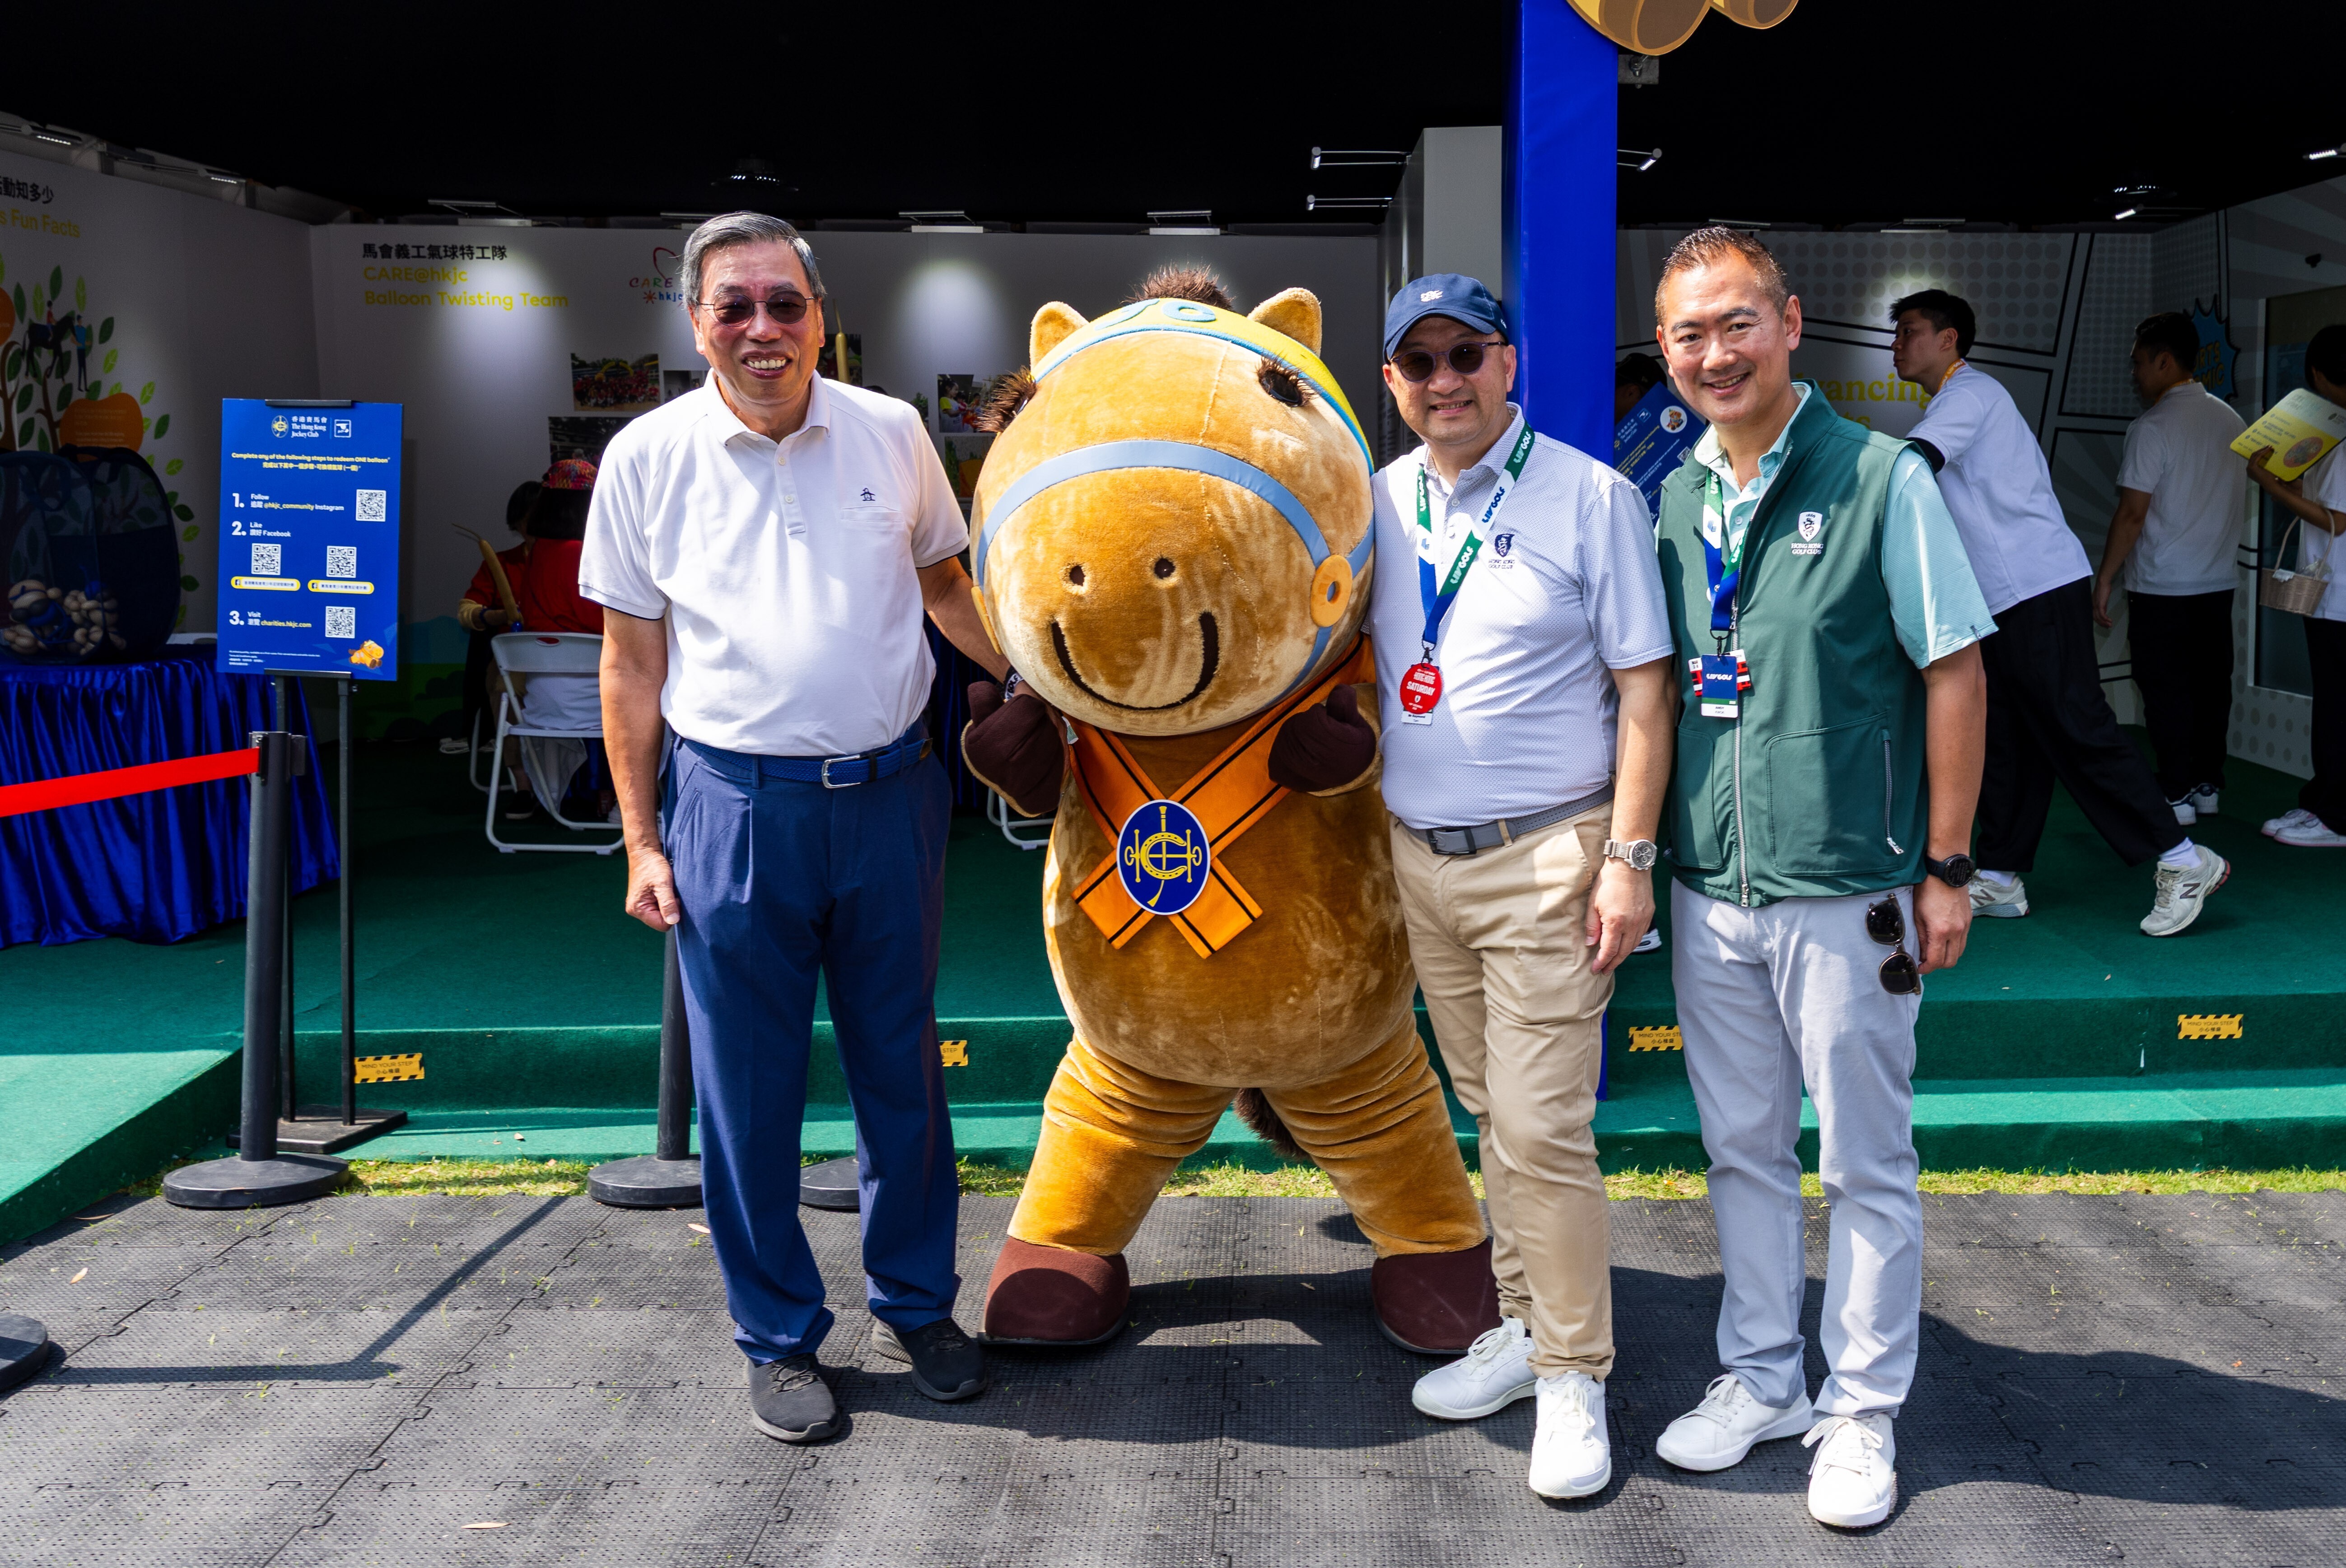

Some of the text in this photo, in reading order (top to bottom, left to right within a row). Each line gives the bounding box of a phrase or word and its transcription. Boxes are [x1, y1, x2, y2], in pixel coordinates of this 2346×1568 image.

[11, 208, 38, 231] Fun
[42, 214, 80, 238] Facts
[362, 243, 507, 261] 馬會義工氣球特工隊
[364, 266, 468, 285] CARE@hkjc
[629, 277, 673, 288] CARE
[365, 291, 568, 311] Balloon Twisting Team
[290, 430, 307, 438] Jockey
[232, 493, 245, 508] 1.
[263, 502, 314, 511] @hkjc_community
[231, 521, 247, 536] 2.
[229, 610, 245, 625] 3.
[260, 620, 312, 628] charities.hkjc.com
[1406, 681, 1436, 696] SATURDAY
[2179, 883, 2201, 899] N
